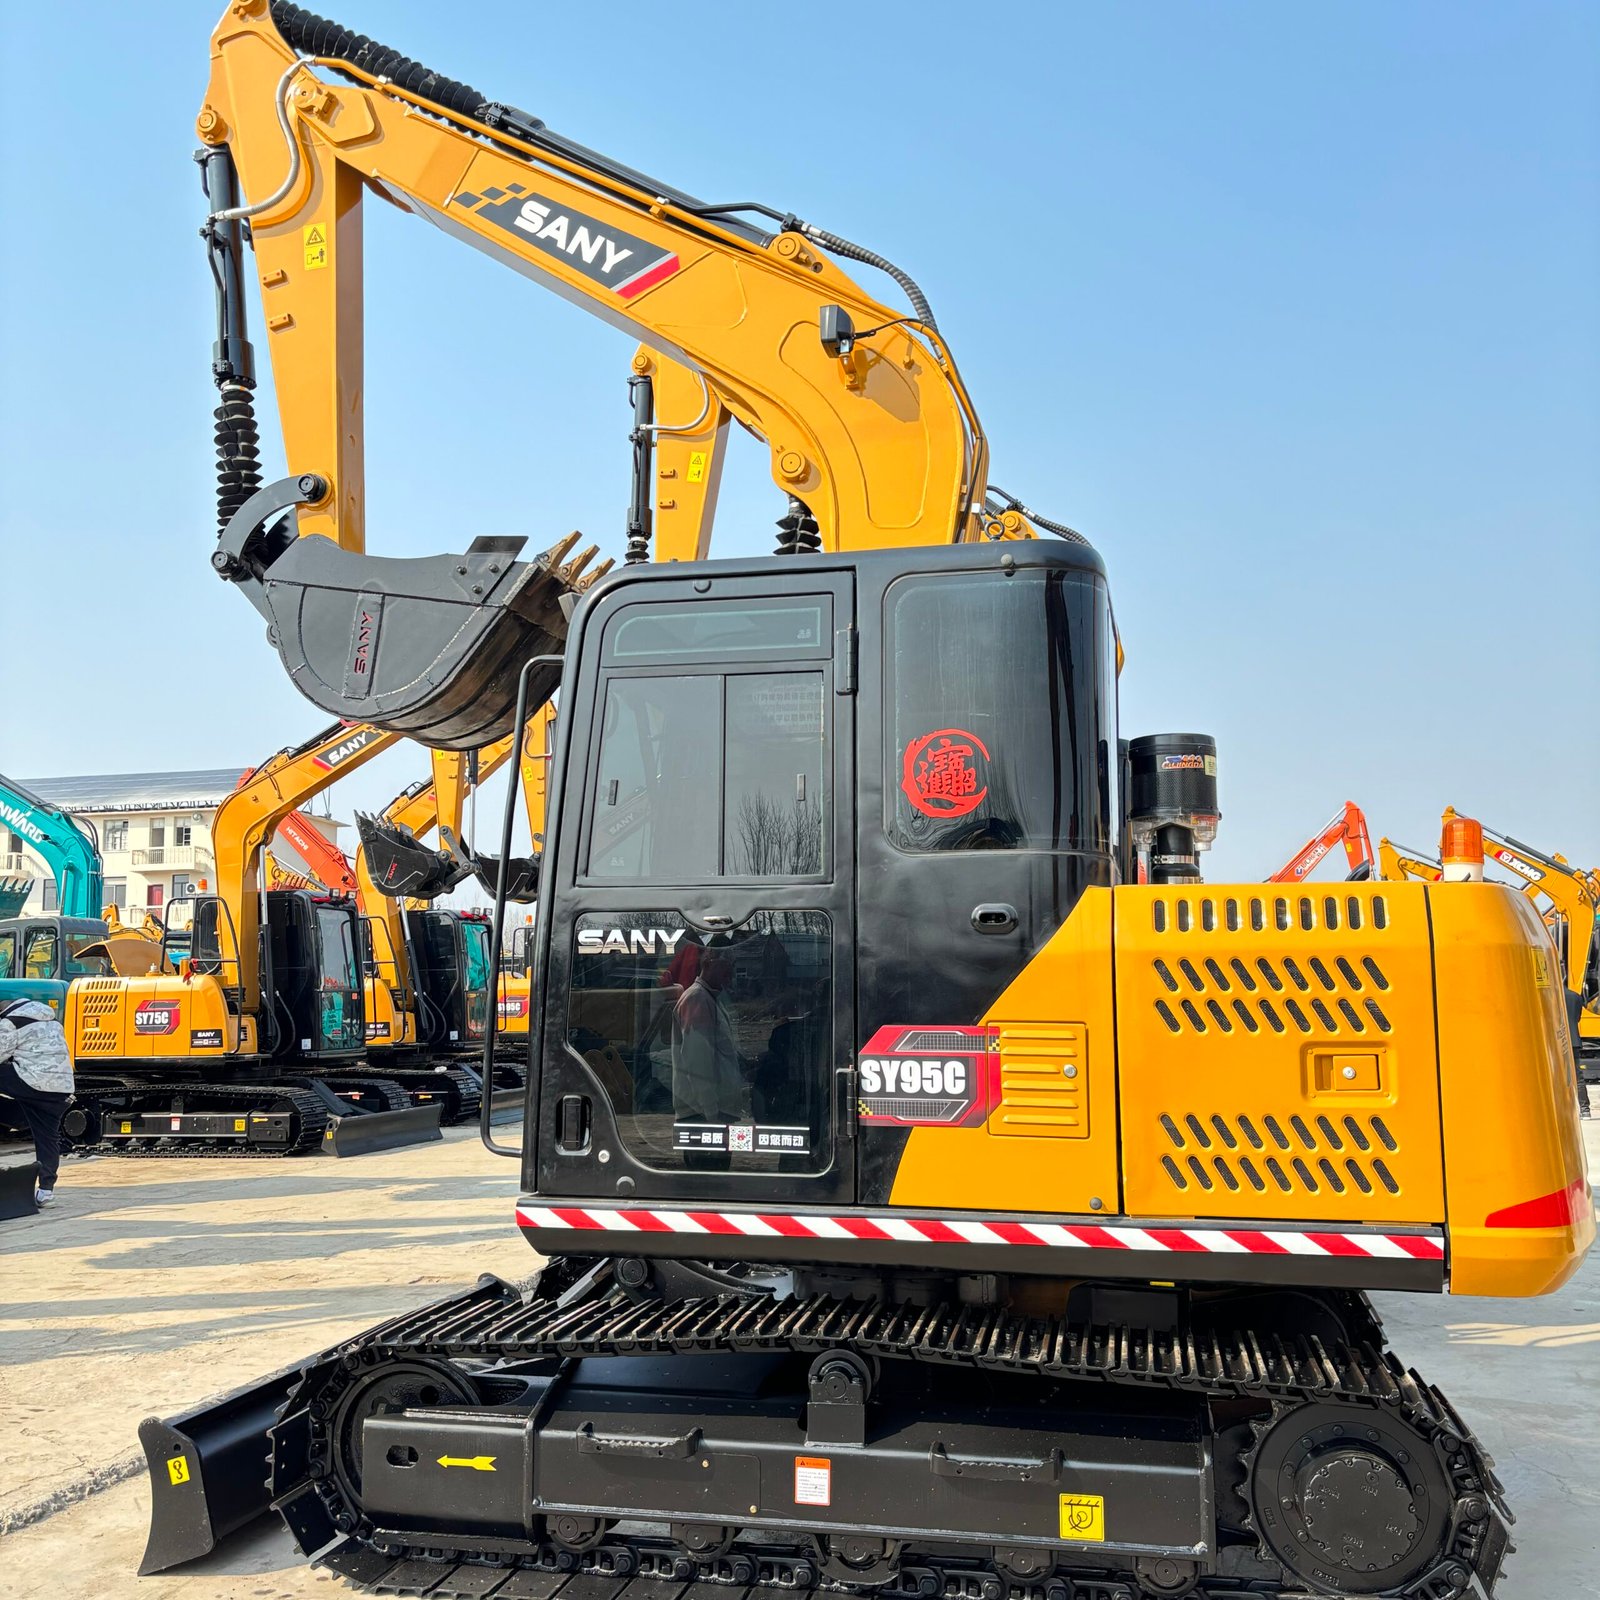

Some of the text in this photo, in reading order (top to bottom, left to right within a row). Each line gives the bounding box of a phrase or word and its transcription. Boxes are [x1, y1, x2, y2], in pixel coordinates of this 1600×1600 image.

[513, 200, 634, 273] SANY
[353, 610, 374, 674] SANY
[328, 731, 367, 764] SANY
[609, 813, 635, 835] SANY
[286, 826, 309, 851] HITACHI
[1509, 857, 1542, 881] XCMG
[577, 928, 686, 954] SANY
[135, 1011, 169, 1025] SY75C
[860, 1059, 966, 1094] SY95C
[679, 1132, 804, 1146] 三一品质 因您而动
